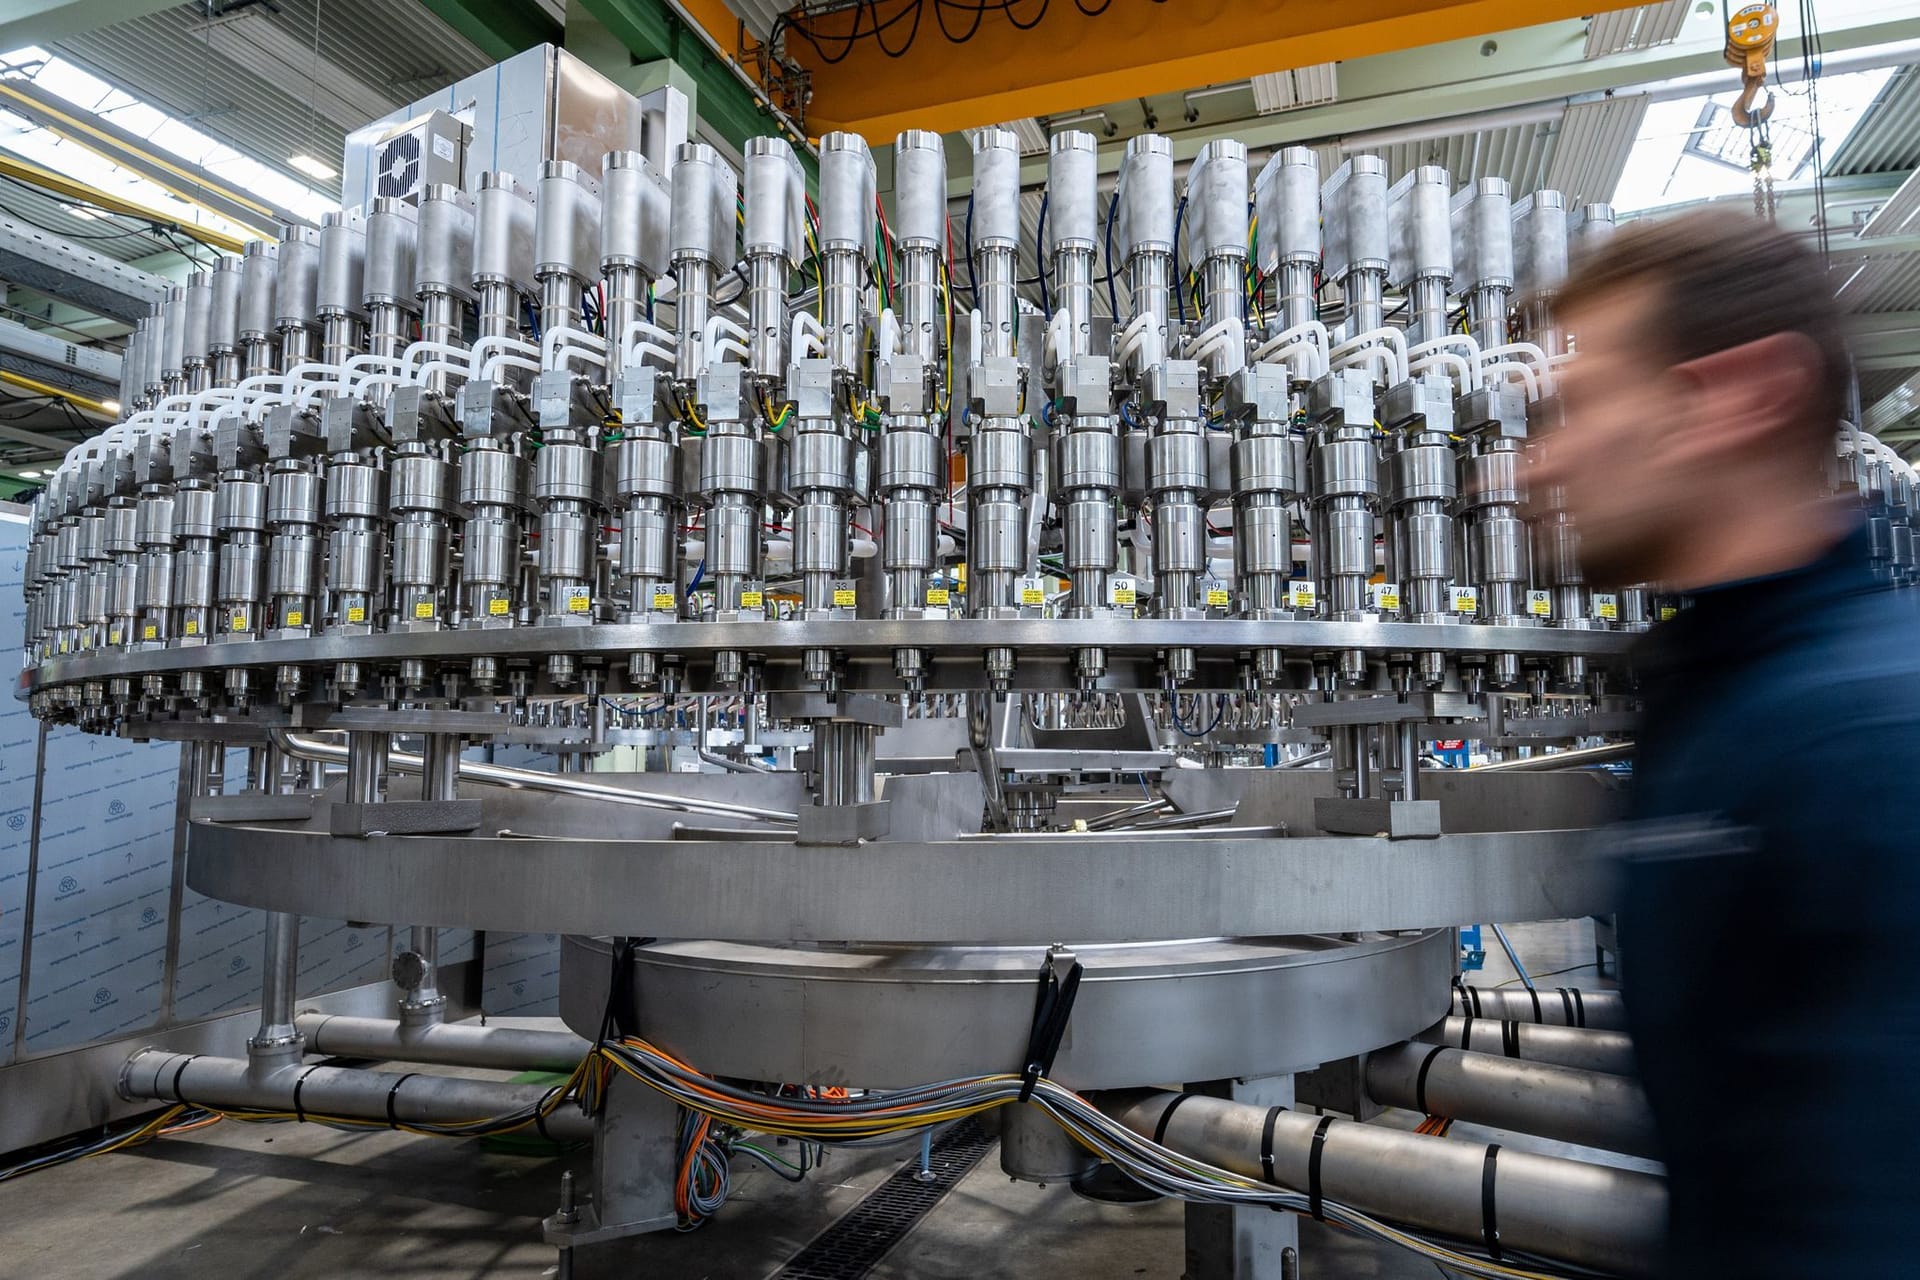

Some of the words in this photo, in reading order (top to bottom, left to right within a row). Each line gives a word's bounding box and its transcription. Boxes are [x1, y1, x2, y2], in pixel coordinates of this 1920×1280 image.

[655, 585, 667, 594] 55
[835, 582, 848, 590] 53
[1023, 581, 1034, 589] 51
[1114, 581, 1127, 590] 50
[1207, 582, 1220, 591] 49
[1296, 583, 1308, 592] 48
[1381, 586, 1392, 595] 47
[1456, 589, 1469, 598] 46
[1532, 593, 1543, 601] 45
